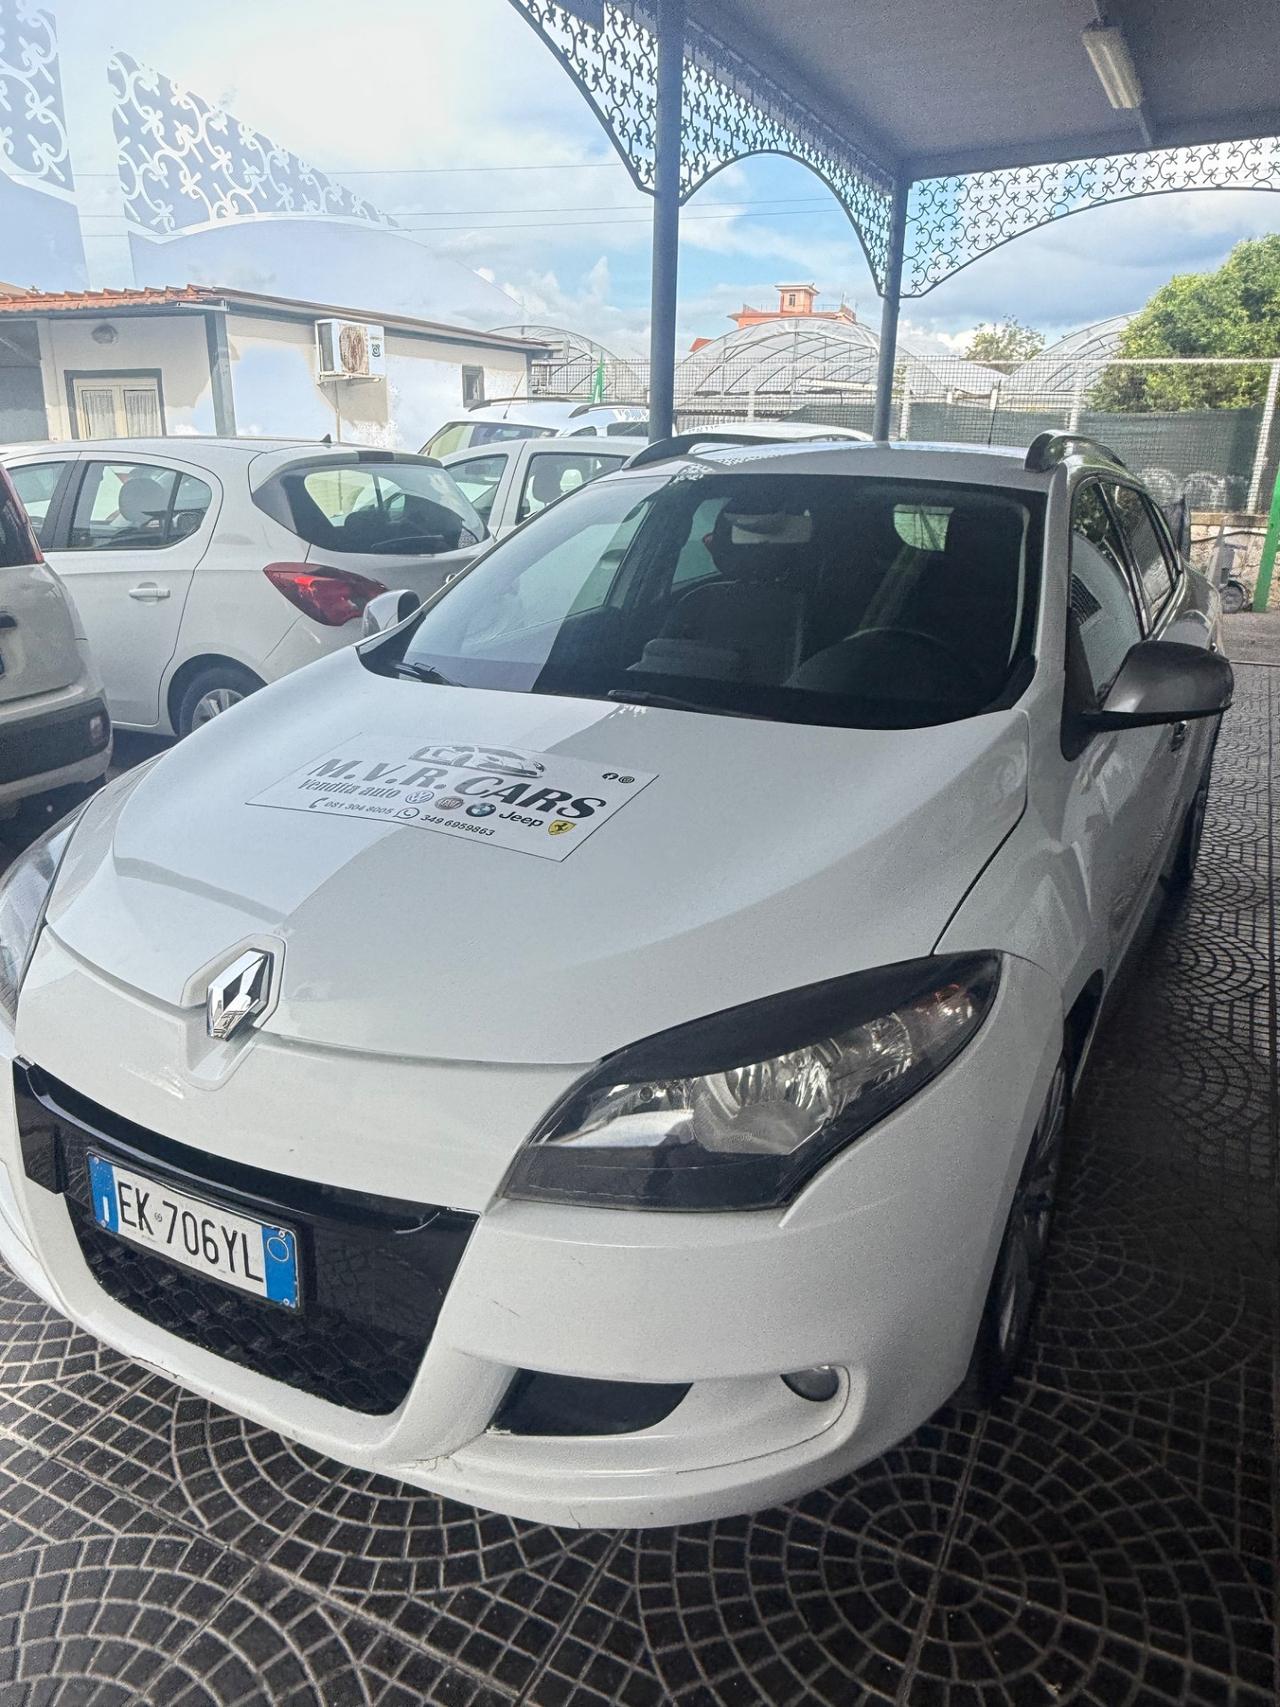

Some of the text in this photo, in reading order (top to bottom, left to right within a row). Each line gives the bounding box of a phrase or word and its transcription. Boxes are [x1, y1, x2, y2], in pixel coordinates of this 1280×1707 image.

[298, 779, 401, 799] Vendita auto
[307, 759, 607, 819] M.V.R. CARS
[420, 814, 496, 837] 349 6959863
[499, 811, 544, 828] Jeep
[118, 1181, 264, 1283] EK 706YL
